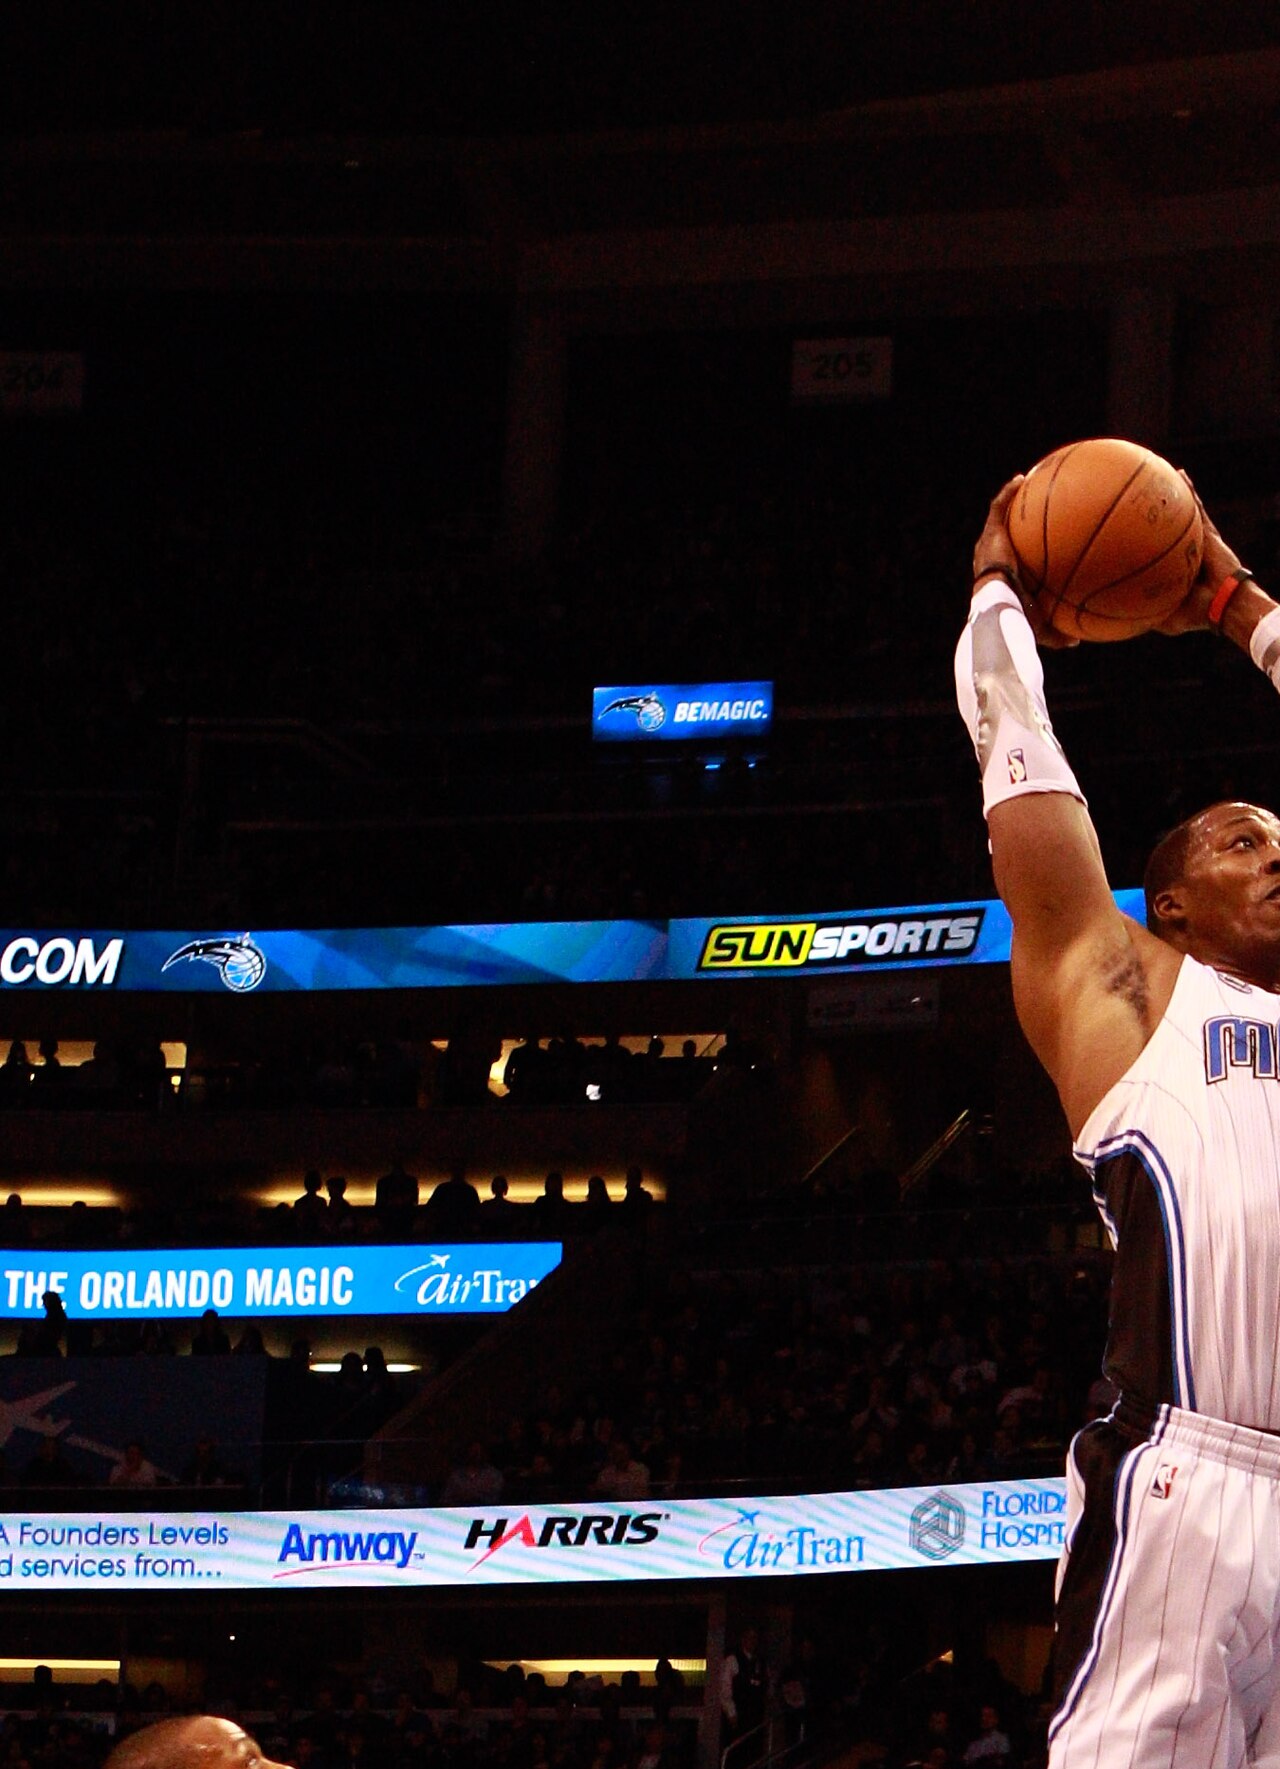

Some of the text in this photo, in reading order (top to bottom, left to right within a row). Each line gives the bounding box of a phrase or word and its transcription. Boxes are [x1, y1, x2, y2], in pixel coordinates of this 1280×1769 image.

[4, 1266, 353, 1309] THE ORLANDO MAGIC
[19, 1522, 139, 1546] Founders
[149, 1521, 228, 1546] Levels
[278, 1523, 417, 1568] Amway
[464, 1514, 661, 1556] HARRIS
[980, 1522, 1066, 1549] HOSPIT
[21, 1553, 126, 1578] services
